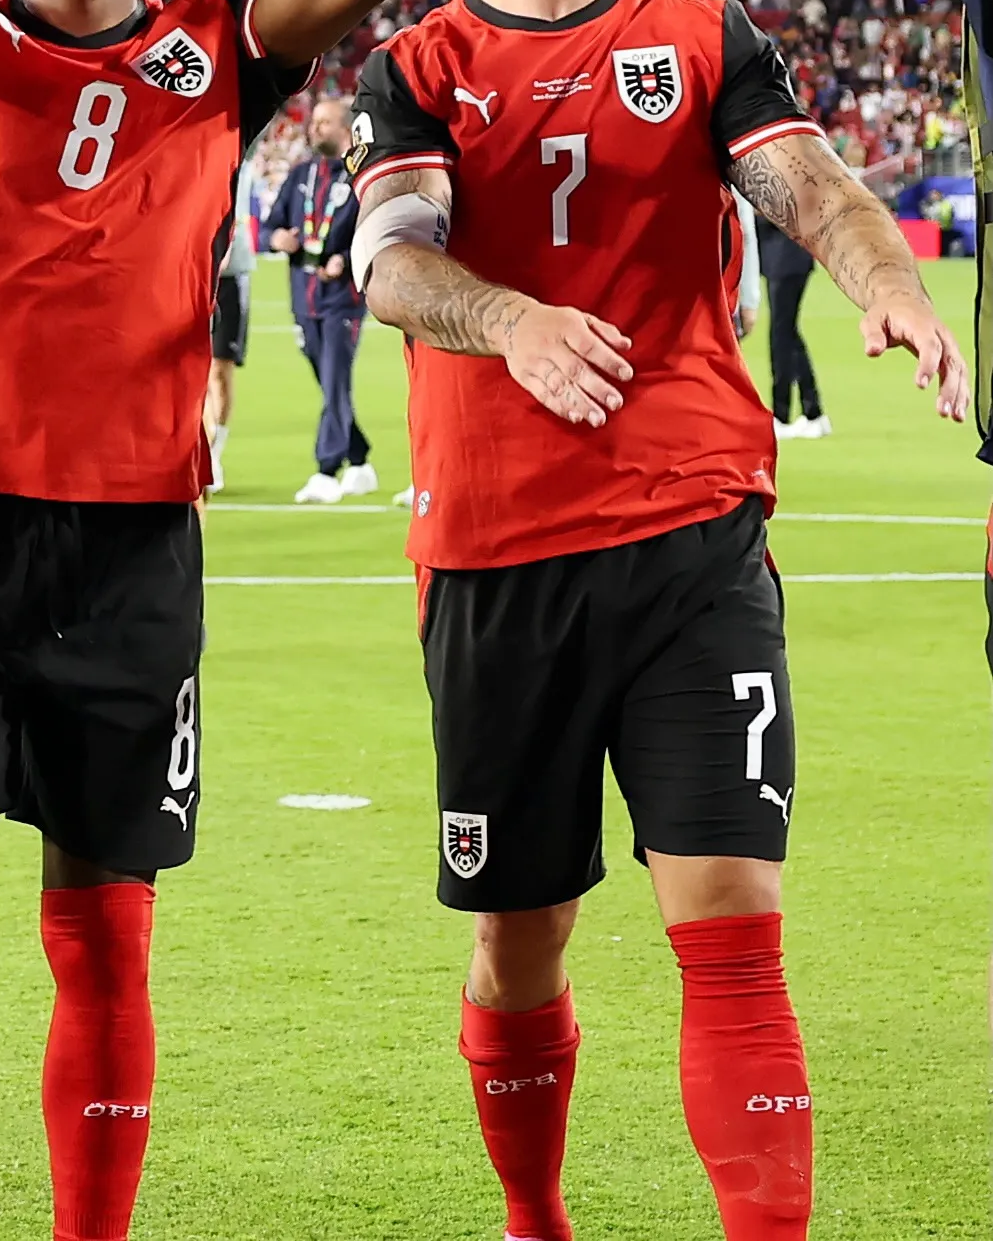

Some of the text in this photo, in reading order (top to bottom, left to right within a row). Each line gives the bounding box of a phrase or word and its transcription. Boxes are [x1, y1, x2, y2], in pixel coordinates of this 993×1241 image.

[58, 80, 127, 190] 8
[541, 133, 588, 247] 7
[167, 675, 196, 791] 8
[731, 672, 777, 780] 7
[83, 1102, 148, 1118] ÖFB
[485, 1072, 557, 1095] ÖFB
[745, 1094, 810, 1114] ÖFB
